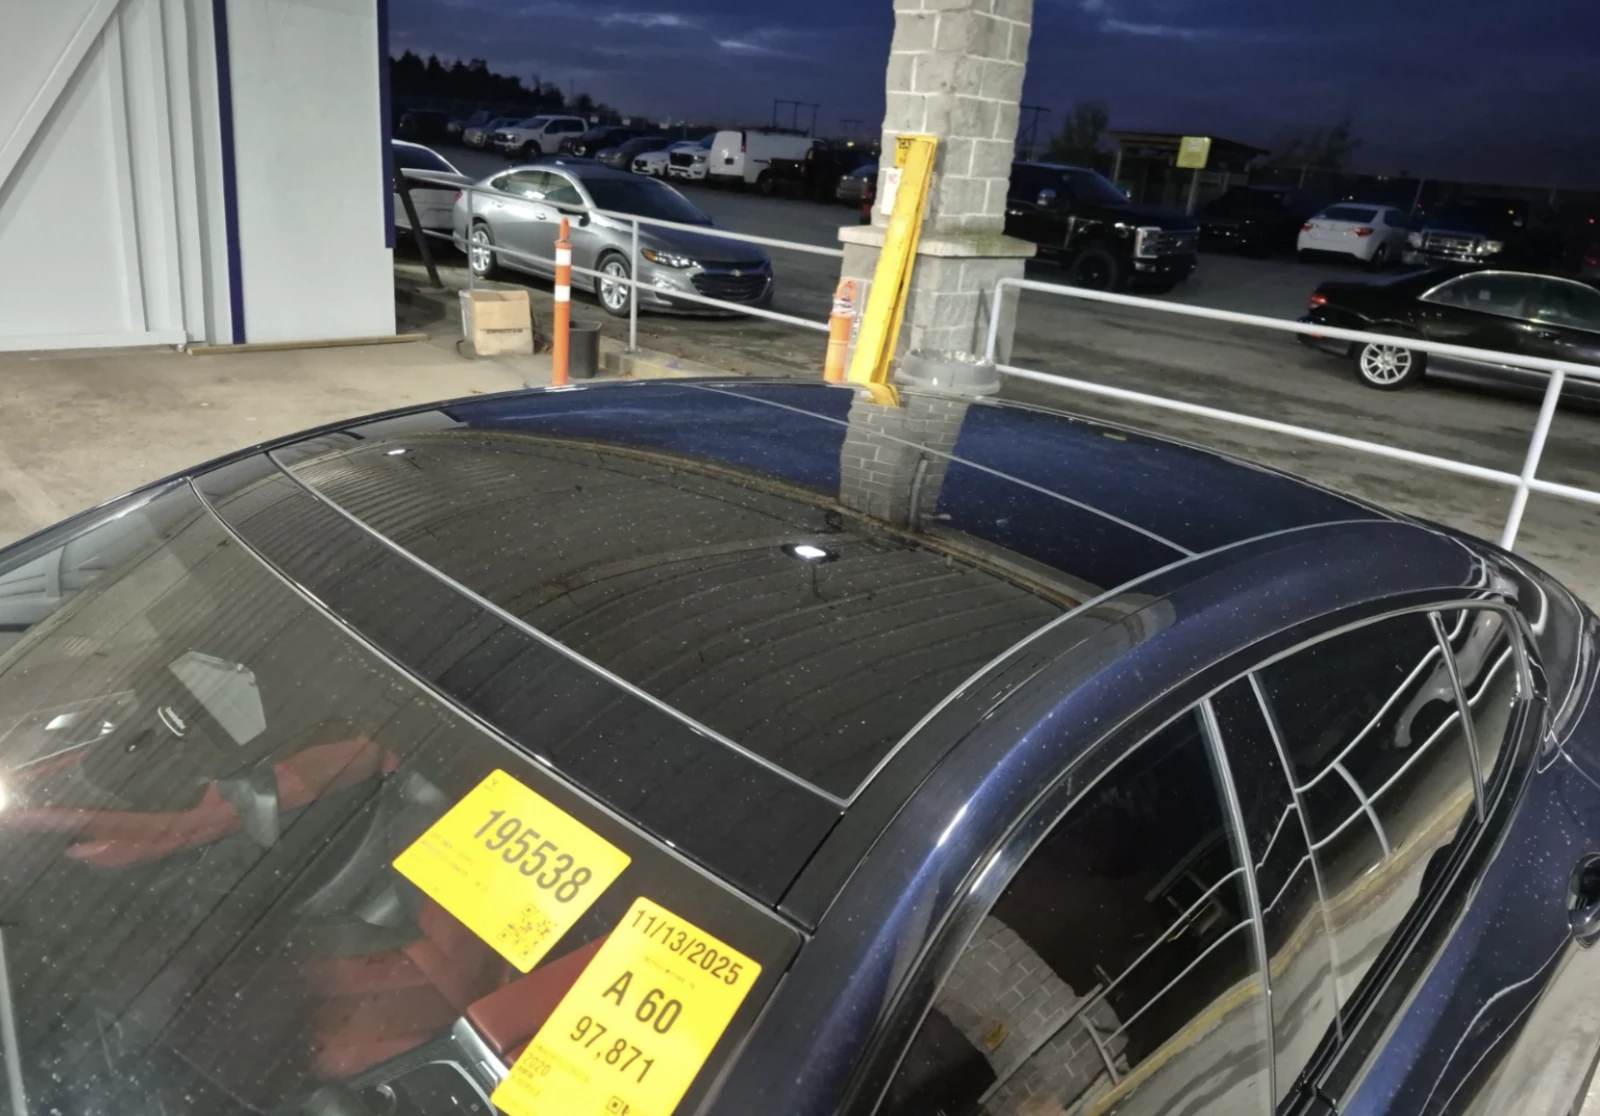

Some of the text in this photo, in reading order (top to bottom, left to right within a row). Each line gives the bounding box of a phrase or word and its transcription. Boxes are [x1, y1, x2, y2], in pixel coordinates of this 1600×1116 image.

[473, 810, 593, 904] 195538
[632, 909, 744, 986] 11/13/2025
[602, 970, 634, 1007] A
[635, 988, 683, 1034] 60
